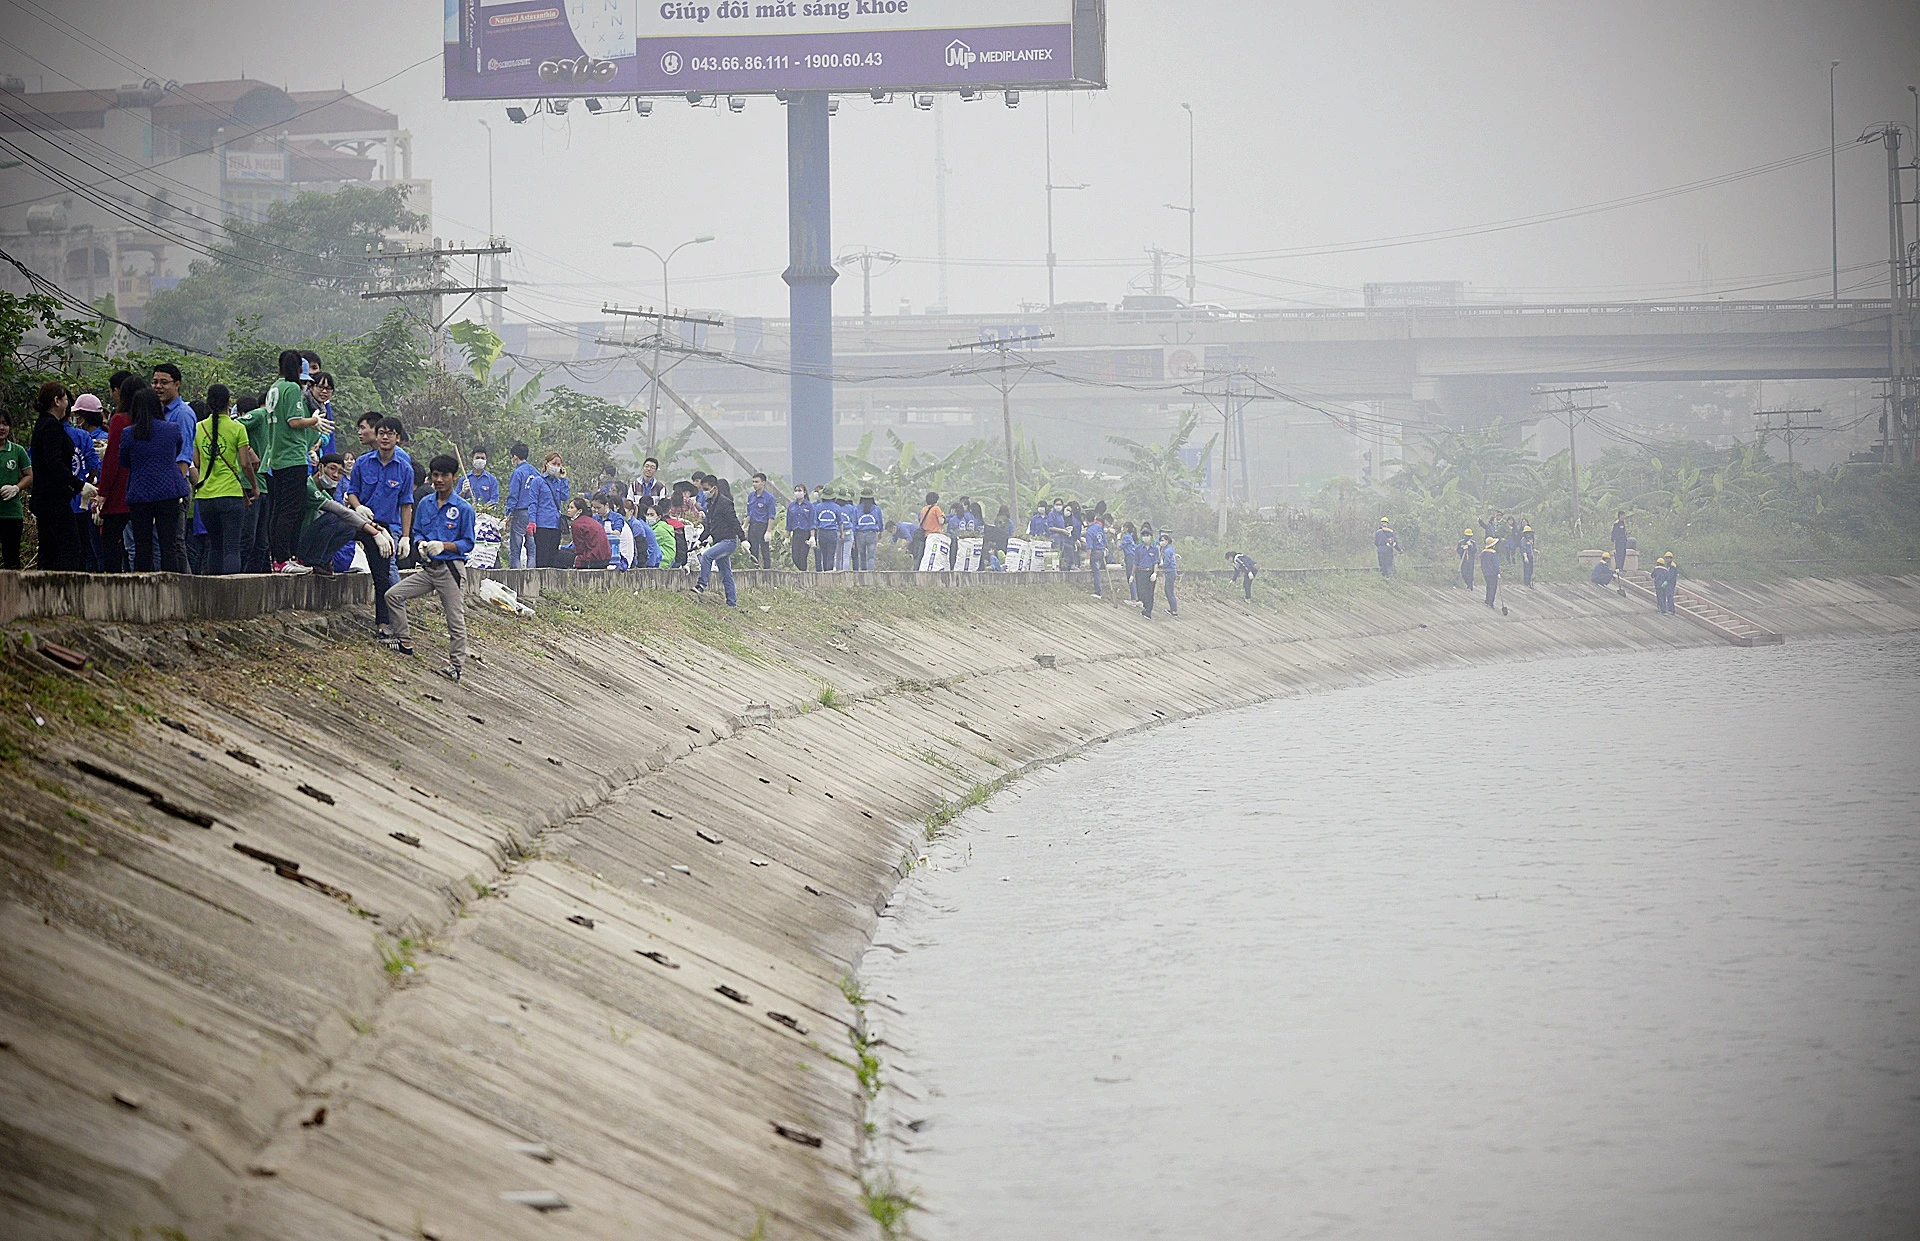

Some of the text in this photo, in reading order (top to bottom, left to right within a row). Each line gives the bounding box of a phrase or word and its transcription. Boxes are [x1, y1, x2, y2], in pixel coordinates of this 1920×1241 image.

[660, 0, 711, 22] Giúp
[717, 0, 750, 19] đôi
[495, 16, 519, 25] Natural
[691, 55, 790, 71] 043.66.86.111
[804, 52, 883, 69] 1900.60.43
[979, 49, 1053, 63] MEDIPLANTEX
